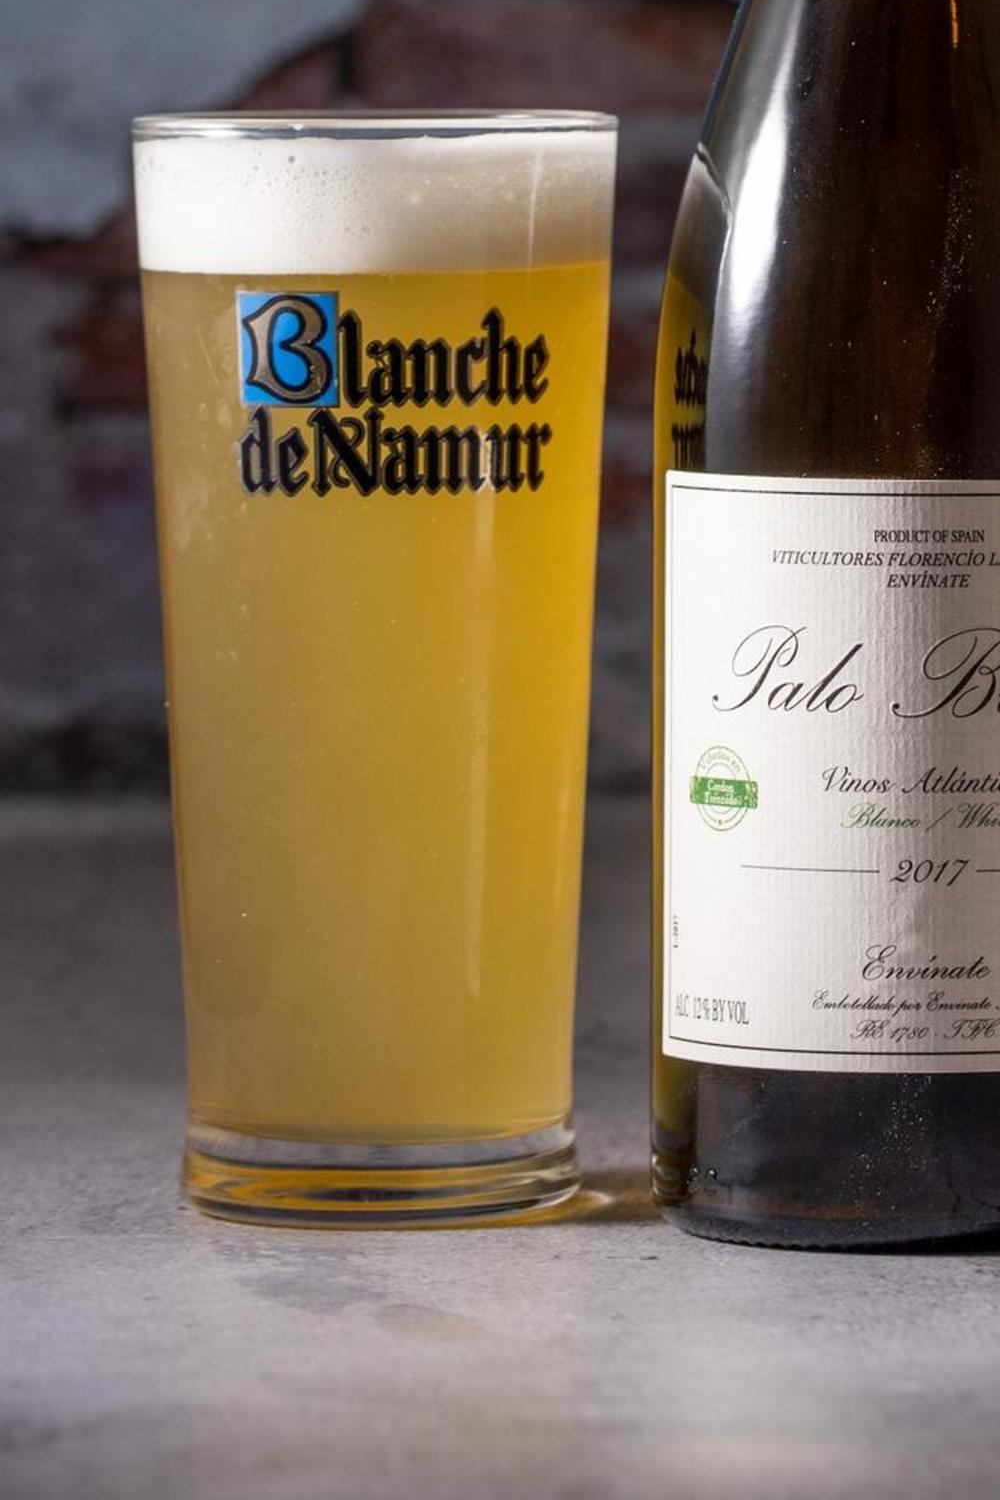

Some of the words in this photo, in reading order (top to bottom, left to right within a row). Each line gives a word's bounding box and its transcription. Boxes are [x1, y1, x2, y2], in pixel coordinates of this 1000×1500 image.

[242, 293, 550, 408] Blanche
[874, 530, 929, 543] PRODUCT
[932, 530, 950, 543] OF
[951, 530, 985, 543] SPAIN
[771, 549, 885, 567] VITICULTORES
[886, 572, 971, 589] ENVÍNATE
[712, 624, 864, 713] Palo
[821, 766, 894, 793] Vinos
[840, 801, 920, 830] Blanco
[888, 858, 971, 887] 2017
[811, 988, 895, 1012] Embotellado
[891, 1000, 923, 1017] por
